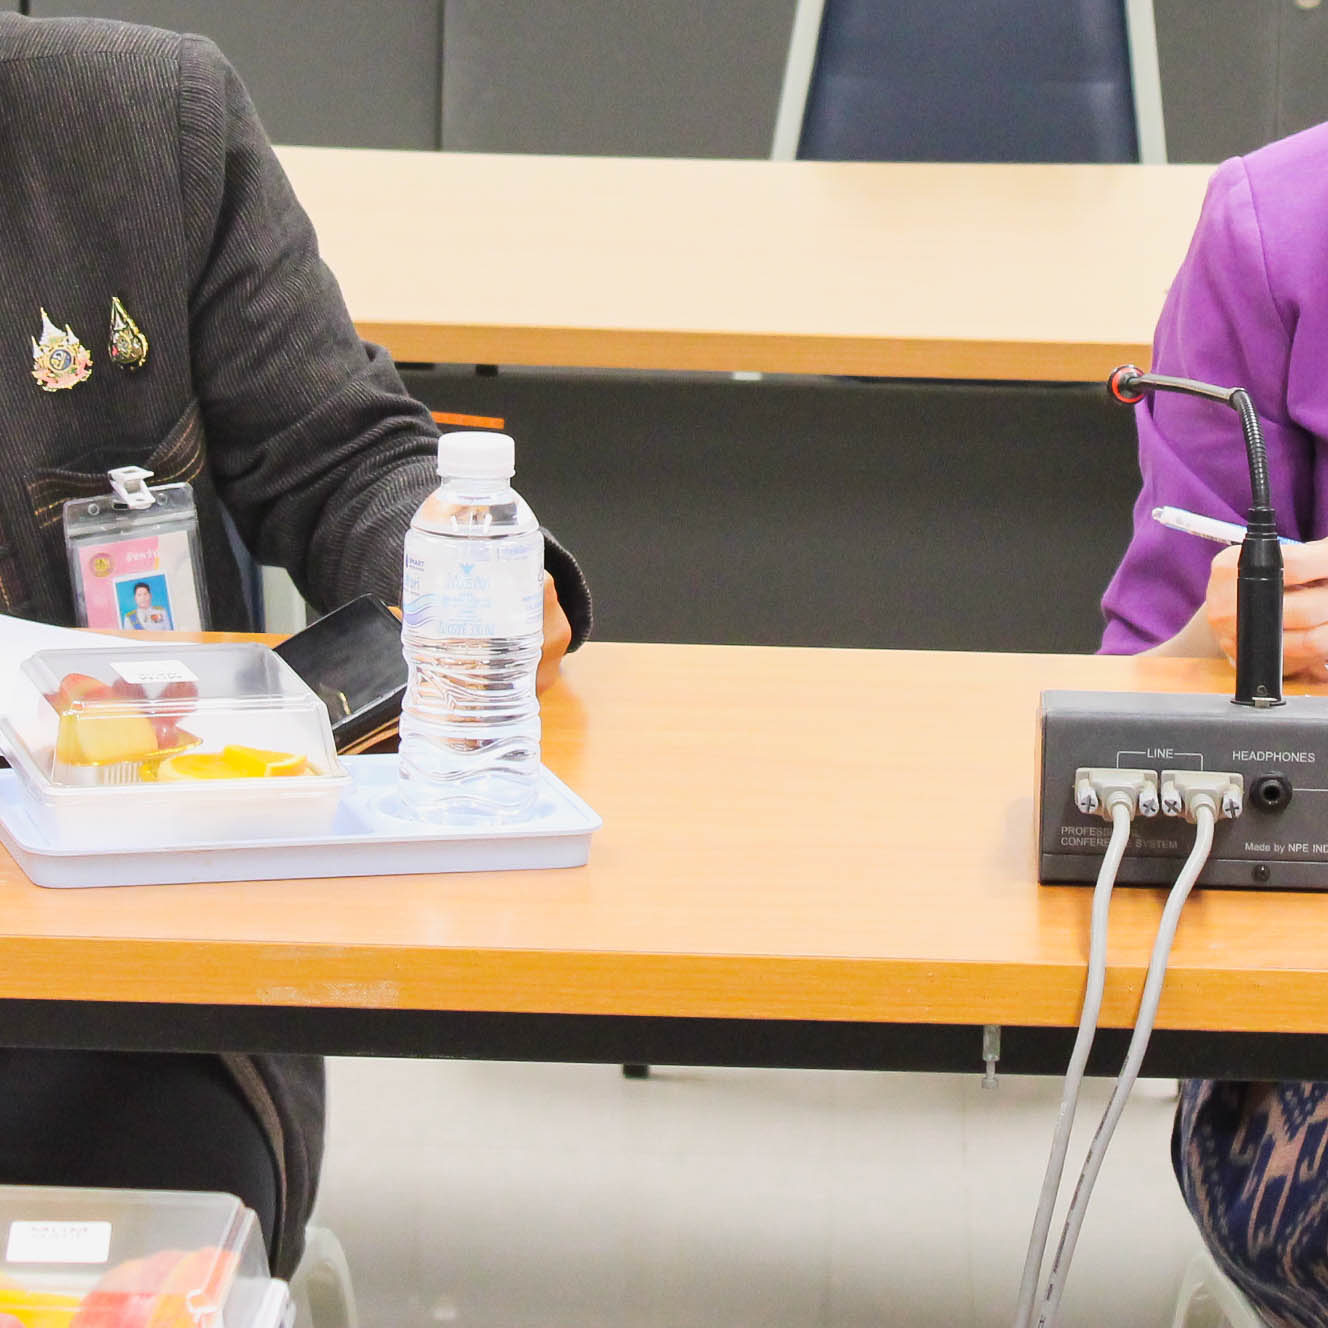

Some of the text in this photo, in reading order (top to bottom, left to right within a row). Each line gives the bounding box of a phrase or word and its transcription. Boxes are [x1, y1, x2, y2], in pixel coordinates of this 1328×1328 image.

[1146, 748, 1174, 759] LINE
[1232, 750, 1316, 763] HEADPHONES
[1136, 838, 1178, 849] SYSTEM
[1244, 842, 1271, 853] Made
[1274, 843, 1285, 854] by
[1288, 843, 1309, 853] NPE
